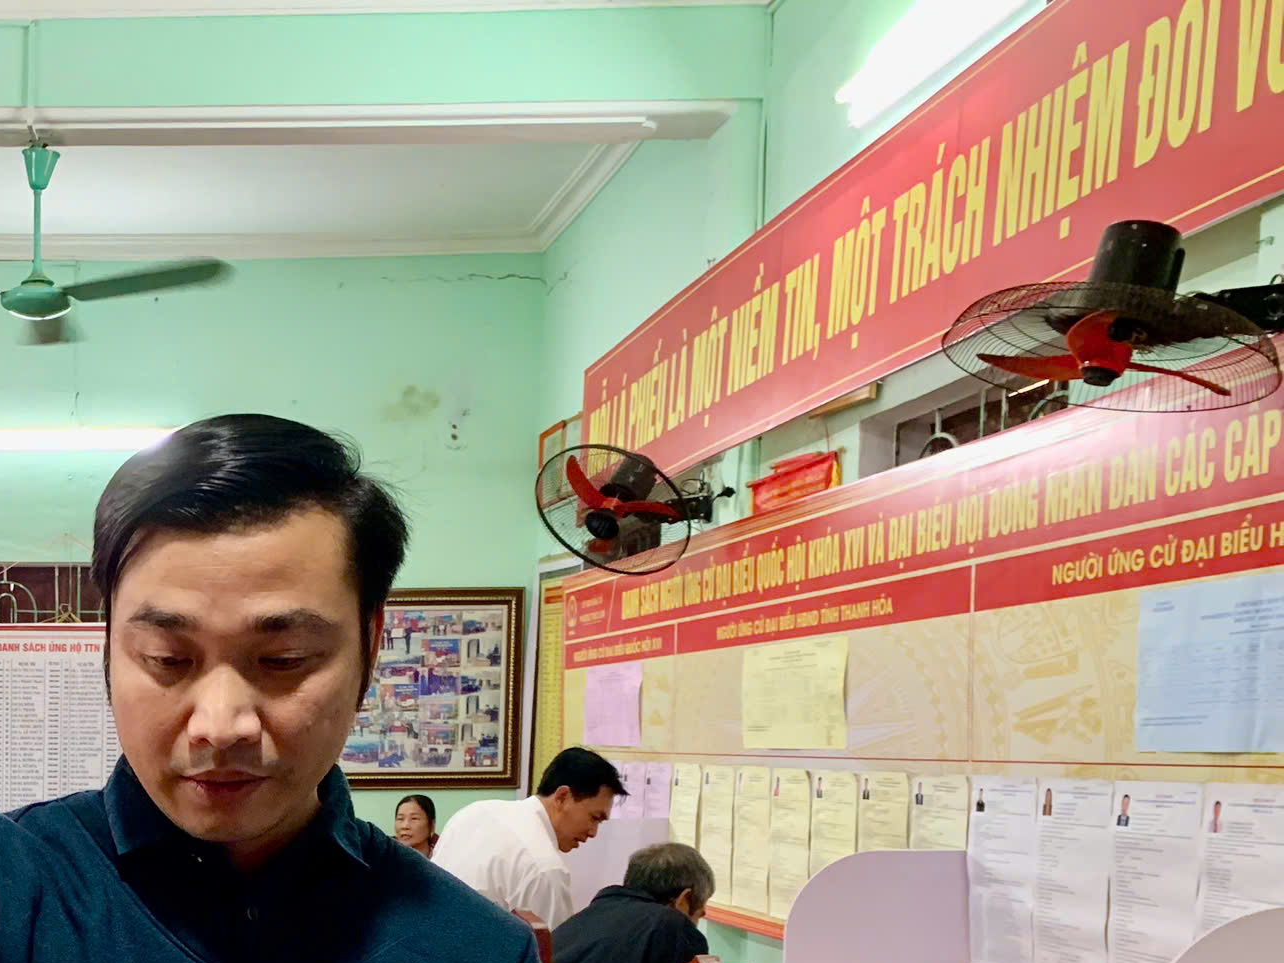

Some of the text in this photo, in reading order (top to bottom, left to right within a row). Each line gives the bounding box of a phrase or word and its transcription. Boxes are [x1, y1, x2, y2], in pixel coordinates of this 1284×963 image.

[627, 338, 668, 452] PHIẾU
[667, 328, 688, 432] LÀ
[689, 305, 728, 428] MỘT
[727, 262, 780, 396] NIỀM
[782, 252, 821, 365] TIN,
[827, 195, 887, 350] MỘT
[889, 135, 991, 304] TRÁCH
[993, 40, 1130, 247] NHIỆM
[757, 536, 785, 595] QUỐC
[787, 535, 807, 592] HỘI
[808, 526, 840, 579] KHÓA
[843, 526, 865, 572] XVI
[868, 512, 885, 567] VÀ
[888, 512, 913, 570] ĐẠI
[916, 495, 953, 556] BIỂU
[1164, 416, 1217, 497] CÁC
[1052, 552, 1104, 586] NGƯỜI
[1107, 548, 1145, 577] ỨNG
[1149, 534, 1179, 569] CỬ
[1181, 535, 1216, 569] ĐẠI
[1220, 513, 1265, 558] BIỂU
[23, 640, 46, 652] SÁCH
